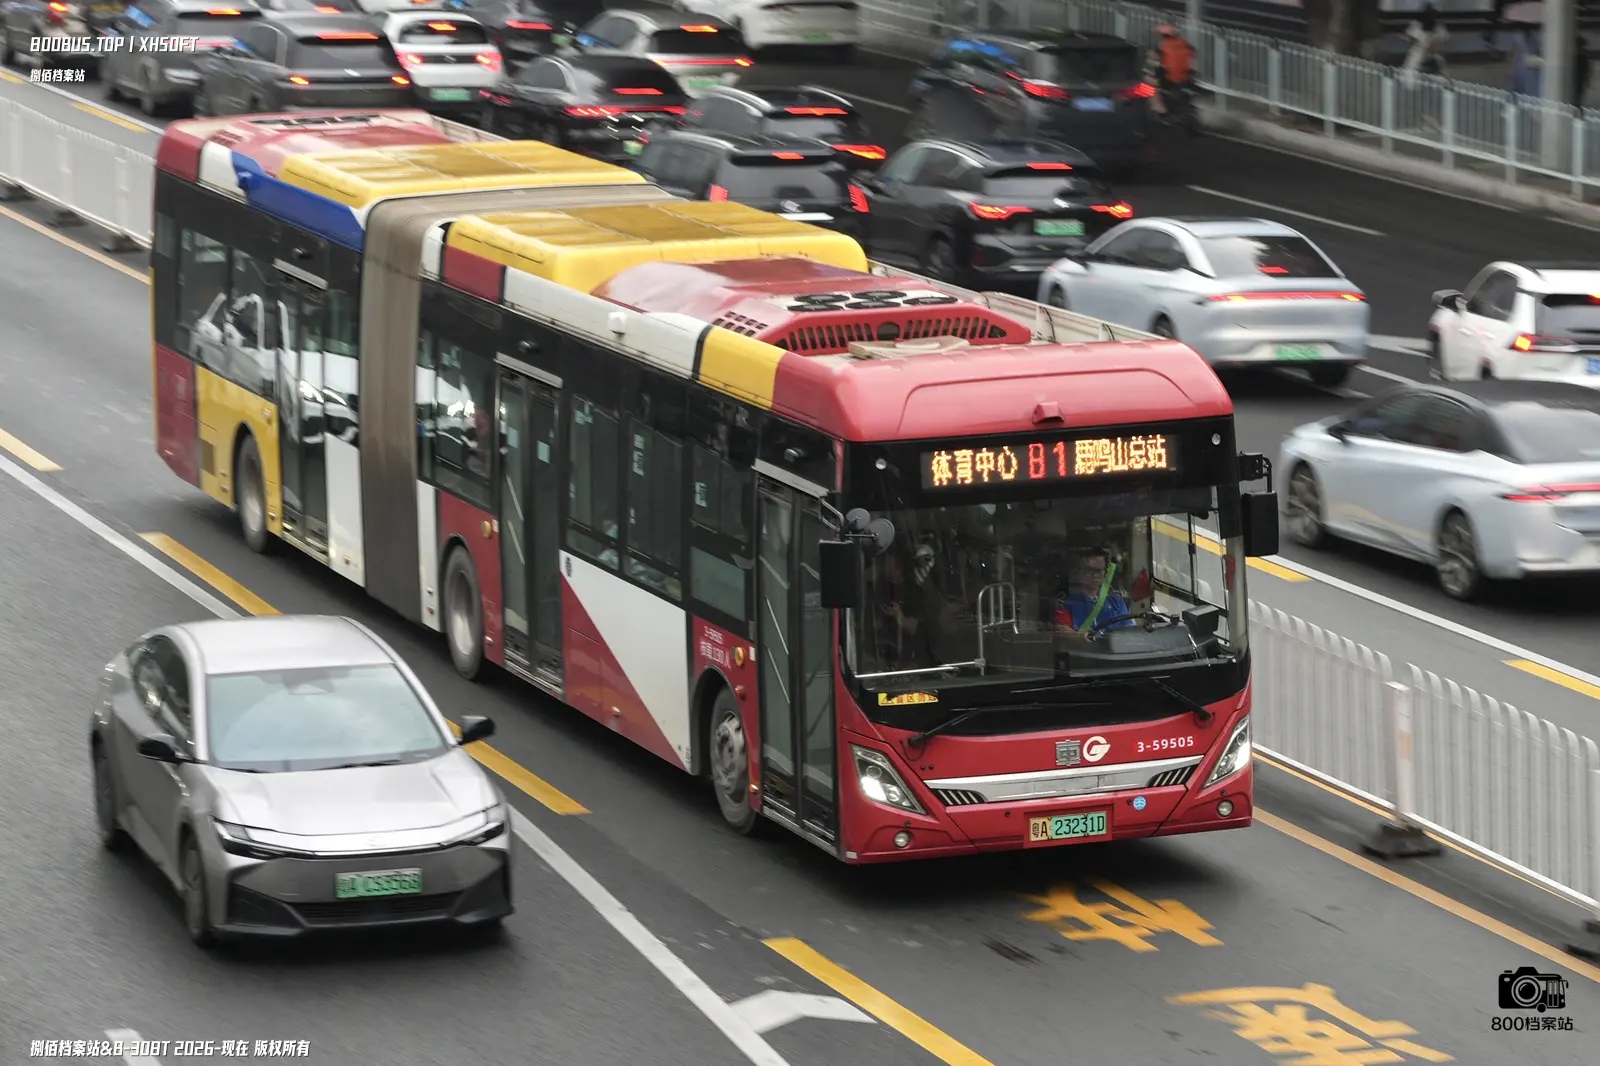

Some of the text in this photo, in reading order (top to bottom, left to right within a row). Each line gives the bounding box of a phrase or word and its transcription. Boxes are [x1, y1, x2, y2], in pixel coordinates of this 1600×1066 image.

[931, 446, 1019, 486] 体育中心
[1137, 735, 1194, 753] 3-59505
